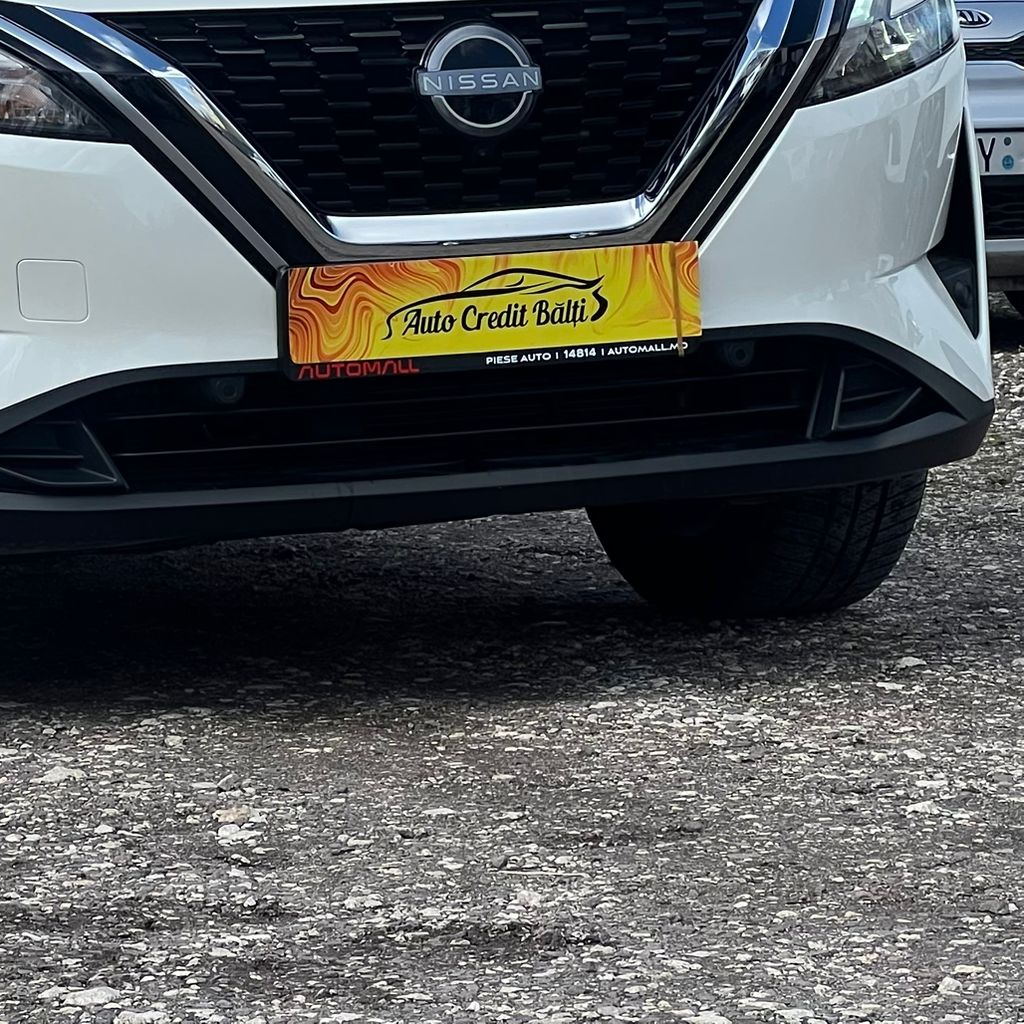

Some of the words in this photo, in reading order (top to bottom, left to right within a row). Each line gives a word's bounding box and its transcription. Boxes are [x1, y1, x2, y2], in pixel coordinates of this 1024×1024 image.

[422, 71, 540, 91] NISSAN
[402, 308, 457, 336] Auto
[461, 303, 529, 331] Credit
[486, 354, 518, 365] PIESE
[520, 352, 552, 363] AUTO
[563, 347, 596, 359] 14814
[298, 360, 420, 380] AUTOMALL
